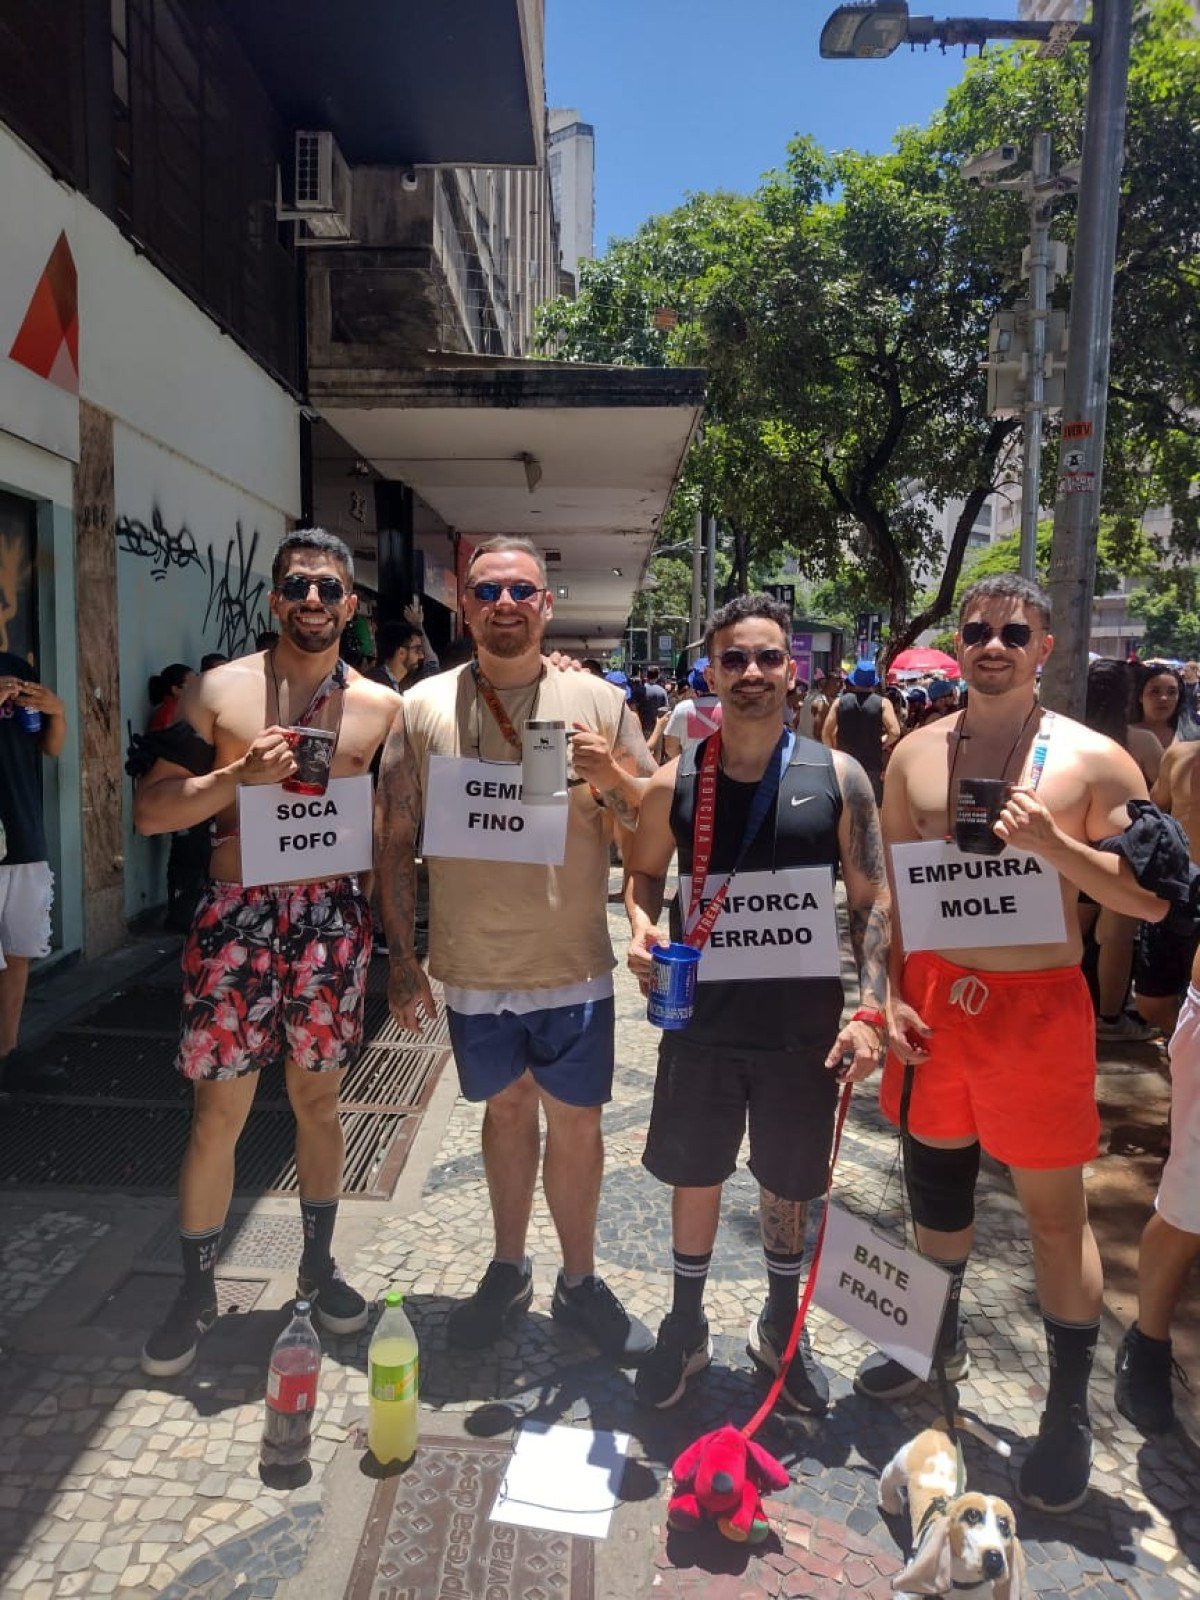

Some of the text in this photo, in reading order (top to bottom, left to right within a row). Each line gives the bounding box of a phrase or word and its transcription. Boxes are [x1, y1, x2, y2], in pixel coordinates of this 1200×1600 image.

[277, 800, 338, 821] SOCA
[698, 765, 715, 842] MEDICINA
[468, 812, 525, 833] FINO
[279, 831, 338, 852] FOFO
[908, 856, 1043, 885] EMPURRA
[940, 896, 1018, 919] MOLE
[710, 927, 813, 948] ERRADO
[853, 1244, 910, 1292] BATE
[839, 1271, 908, 1326] FRACO
[439, 1512, 476, 1600] presa
